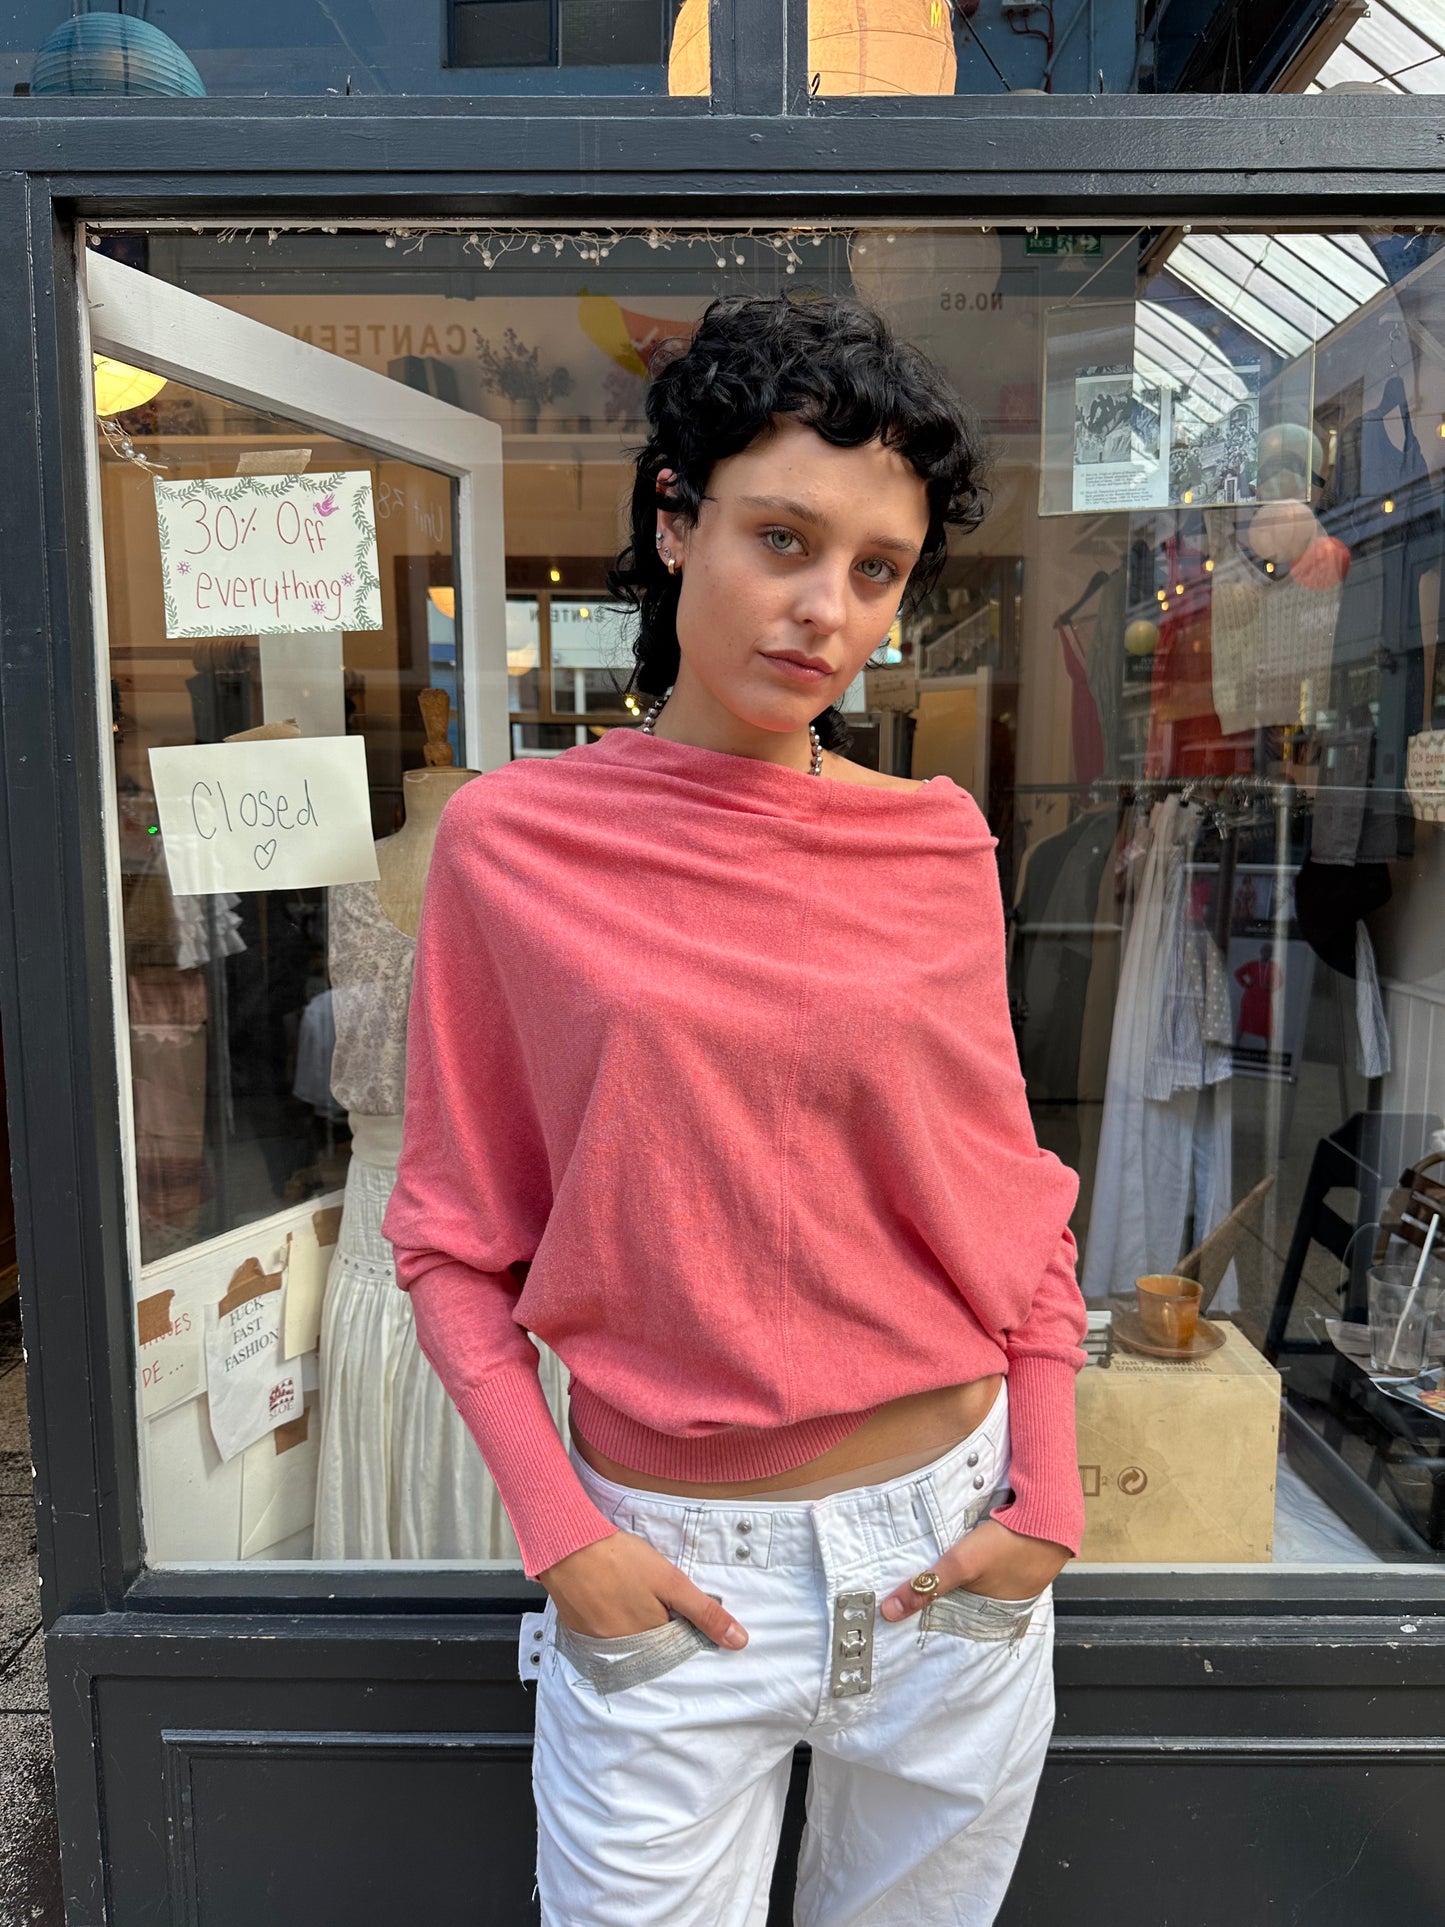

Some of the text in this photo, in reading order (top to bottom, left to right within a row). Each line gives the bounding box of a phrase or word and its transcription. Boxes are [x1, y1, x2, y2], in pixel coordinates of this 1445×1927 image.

[181, 498, 327, 555] 30% Off
[196, 569, 342, 621] everything
[191, 778, 319, 840] Closed
[229, 1295, 265, 1327] FUCK
[232, 1316, 263, 1345] FAST
[224, 1327, 281, 1374] FASHION
